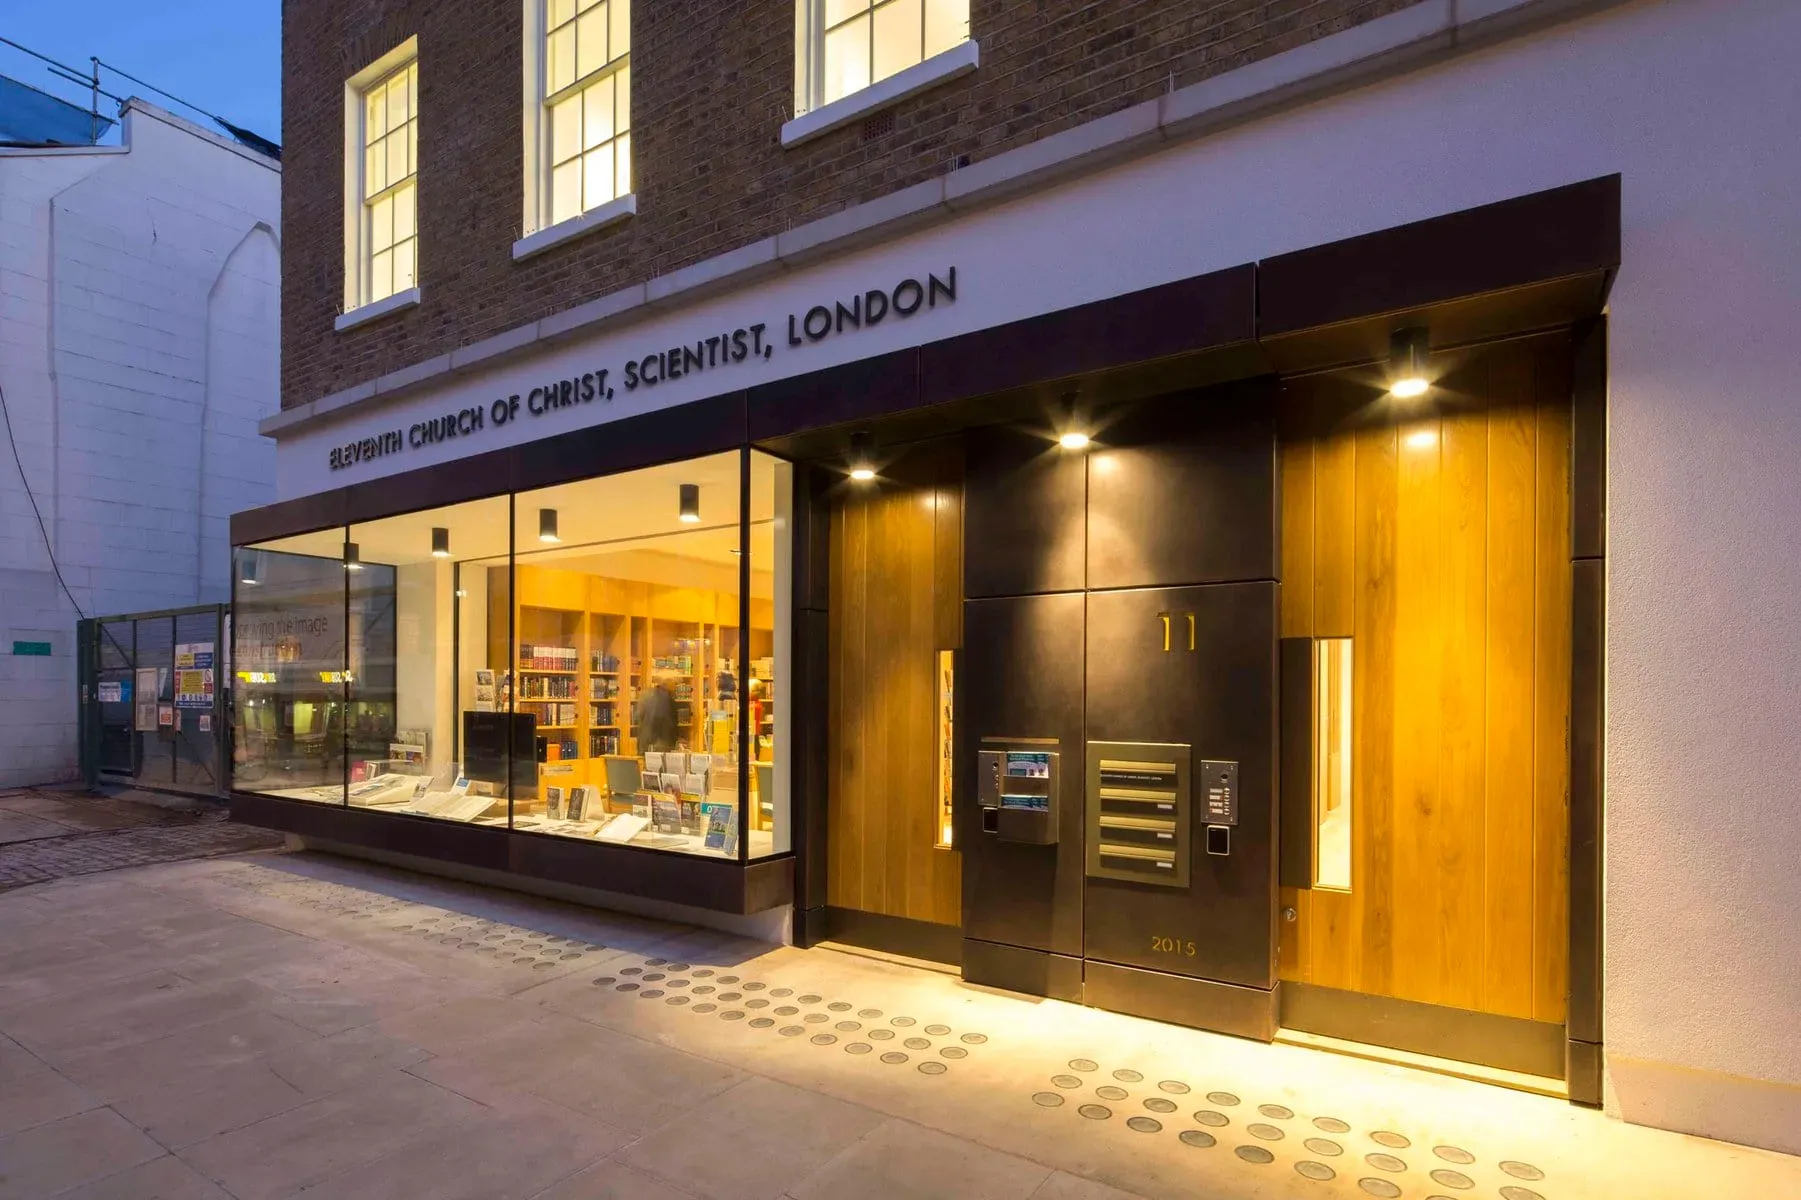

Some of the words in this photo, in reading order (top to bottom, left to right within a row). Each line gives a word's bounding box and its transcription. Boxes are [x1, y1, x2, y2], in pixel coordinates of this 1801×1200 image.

[329, 429, 402, 470] ELEVENTH
[408, 405, 484, 448] CHURCH
[490, 394, 520, 426] OF
[527, 368, 614, 416] CHRIST,
[624, 323, 773, 390] SCIENTIST,
[788, 266, 957, 347] LONDON
[294, 615, 328, 638] image
[1157, 612, 1196, 653] 11
[1151, 936, 1196, 957] 2015
